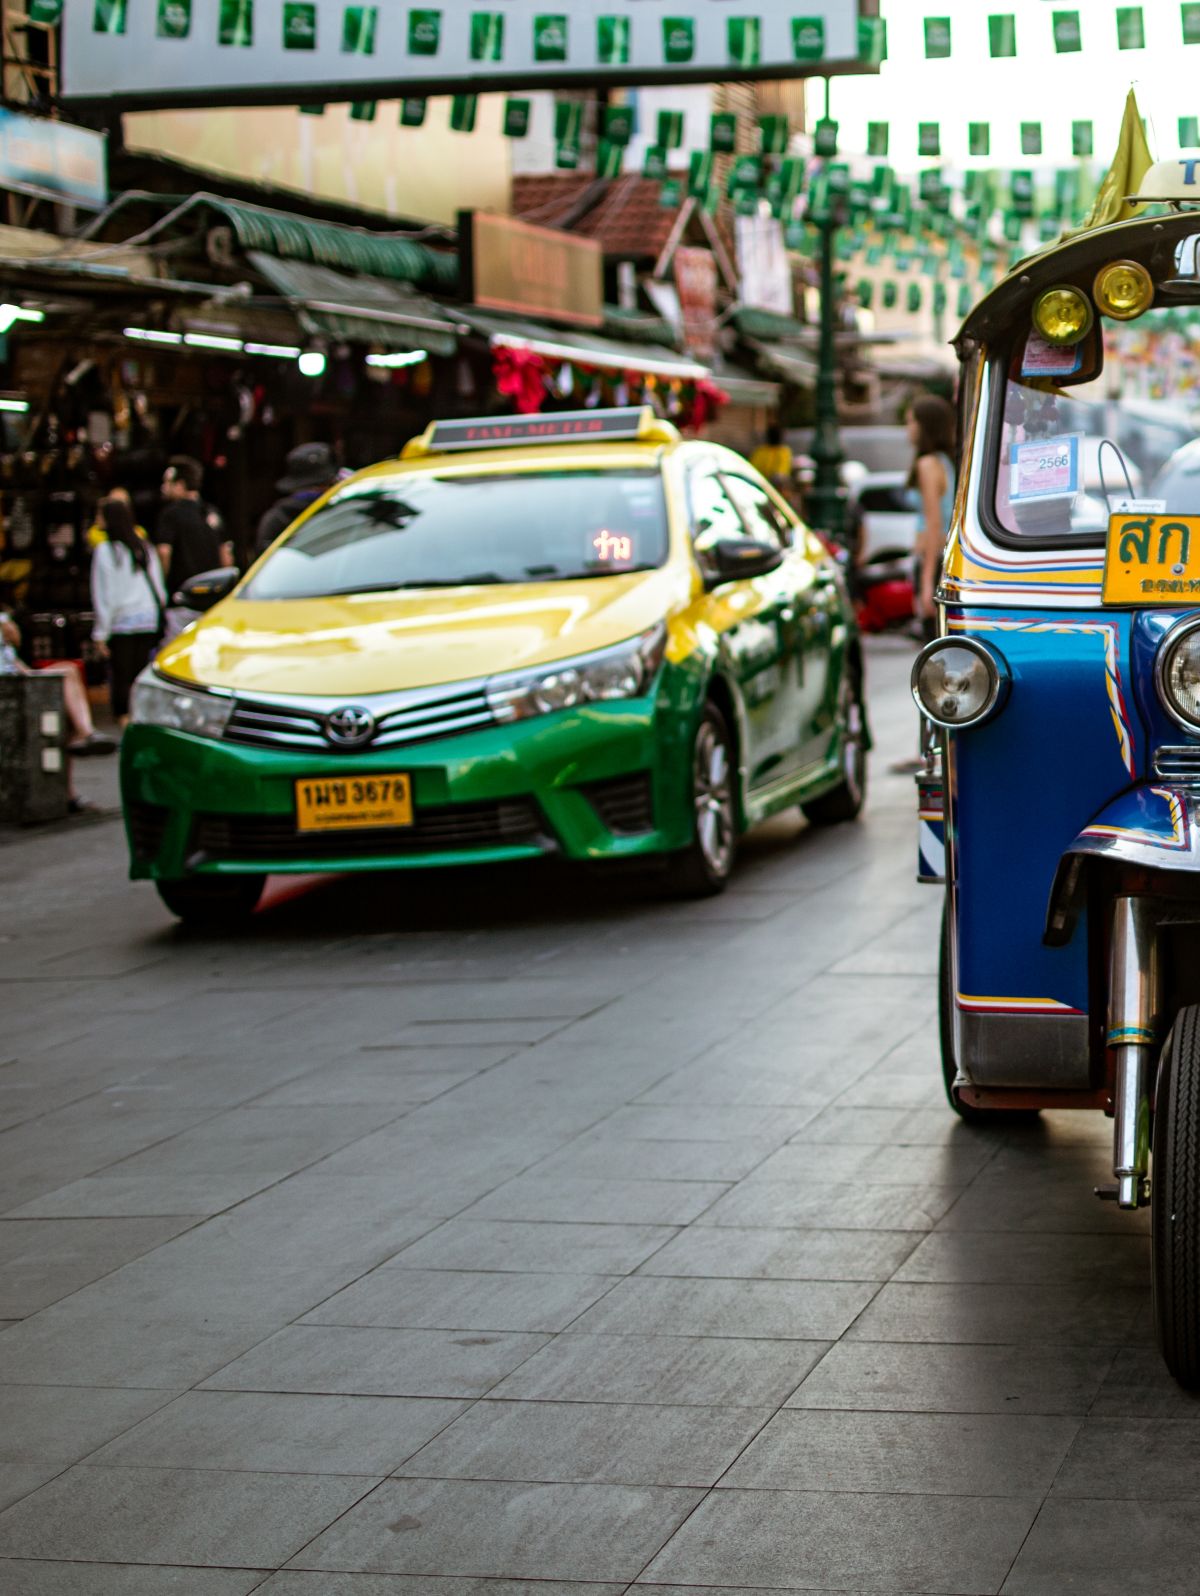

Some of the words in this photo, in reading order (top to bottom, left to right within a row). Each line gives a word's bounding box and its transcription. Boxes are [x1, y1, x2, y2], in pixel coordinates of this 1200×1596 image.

[1039, 454, 1069, 470] 2566
[1119, 517, 1190, 565] สก
[352, 780, 405, 804] 3678
